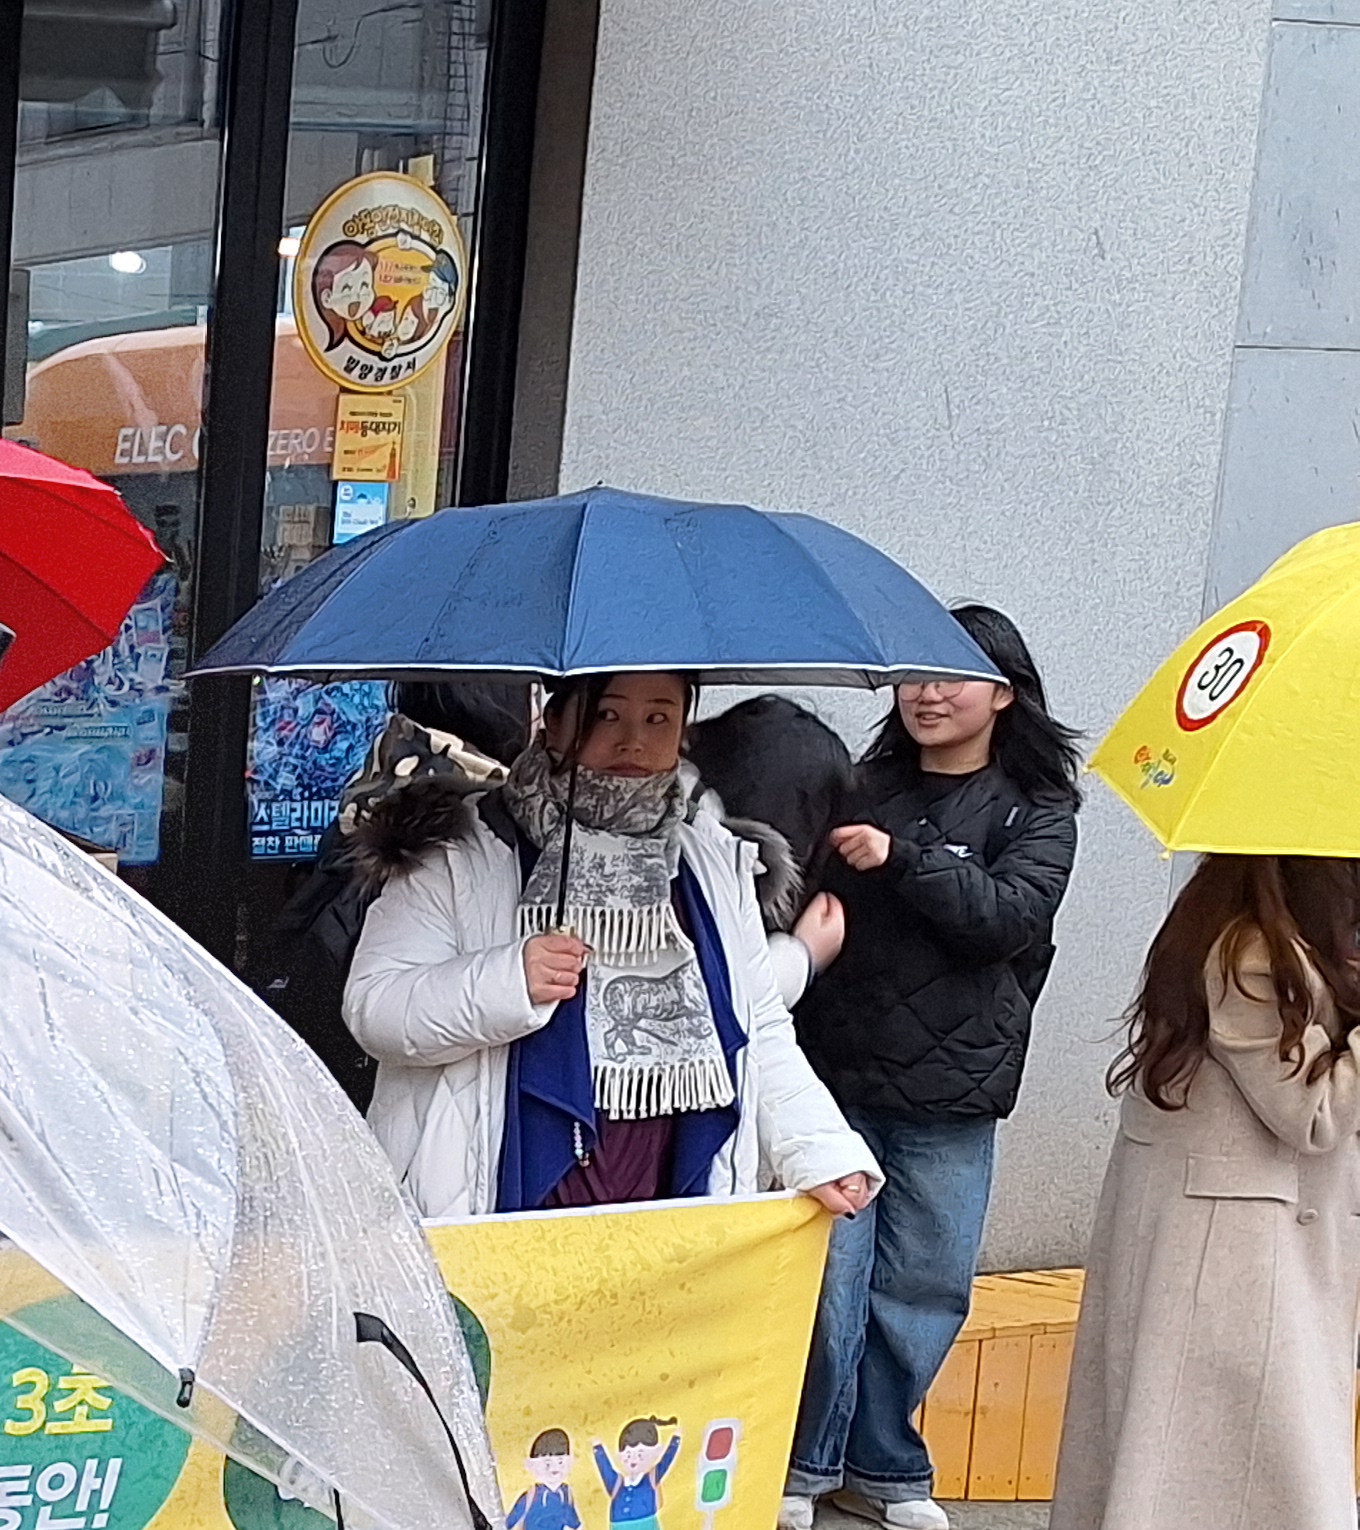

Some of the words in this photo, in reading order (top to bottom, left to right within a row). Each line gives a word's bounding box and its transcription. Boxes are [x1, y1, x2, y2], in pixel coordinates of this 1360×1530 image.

[343, 355, 417, 382] 밀양경찰서
[114, 423, 187, 465] ELEC
[1196, 646, 1245, 702] 30
[2, 1363, 114, 1437] 3초
